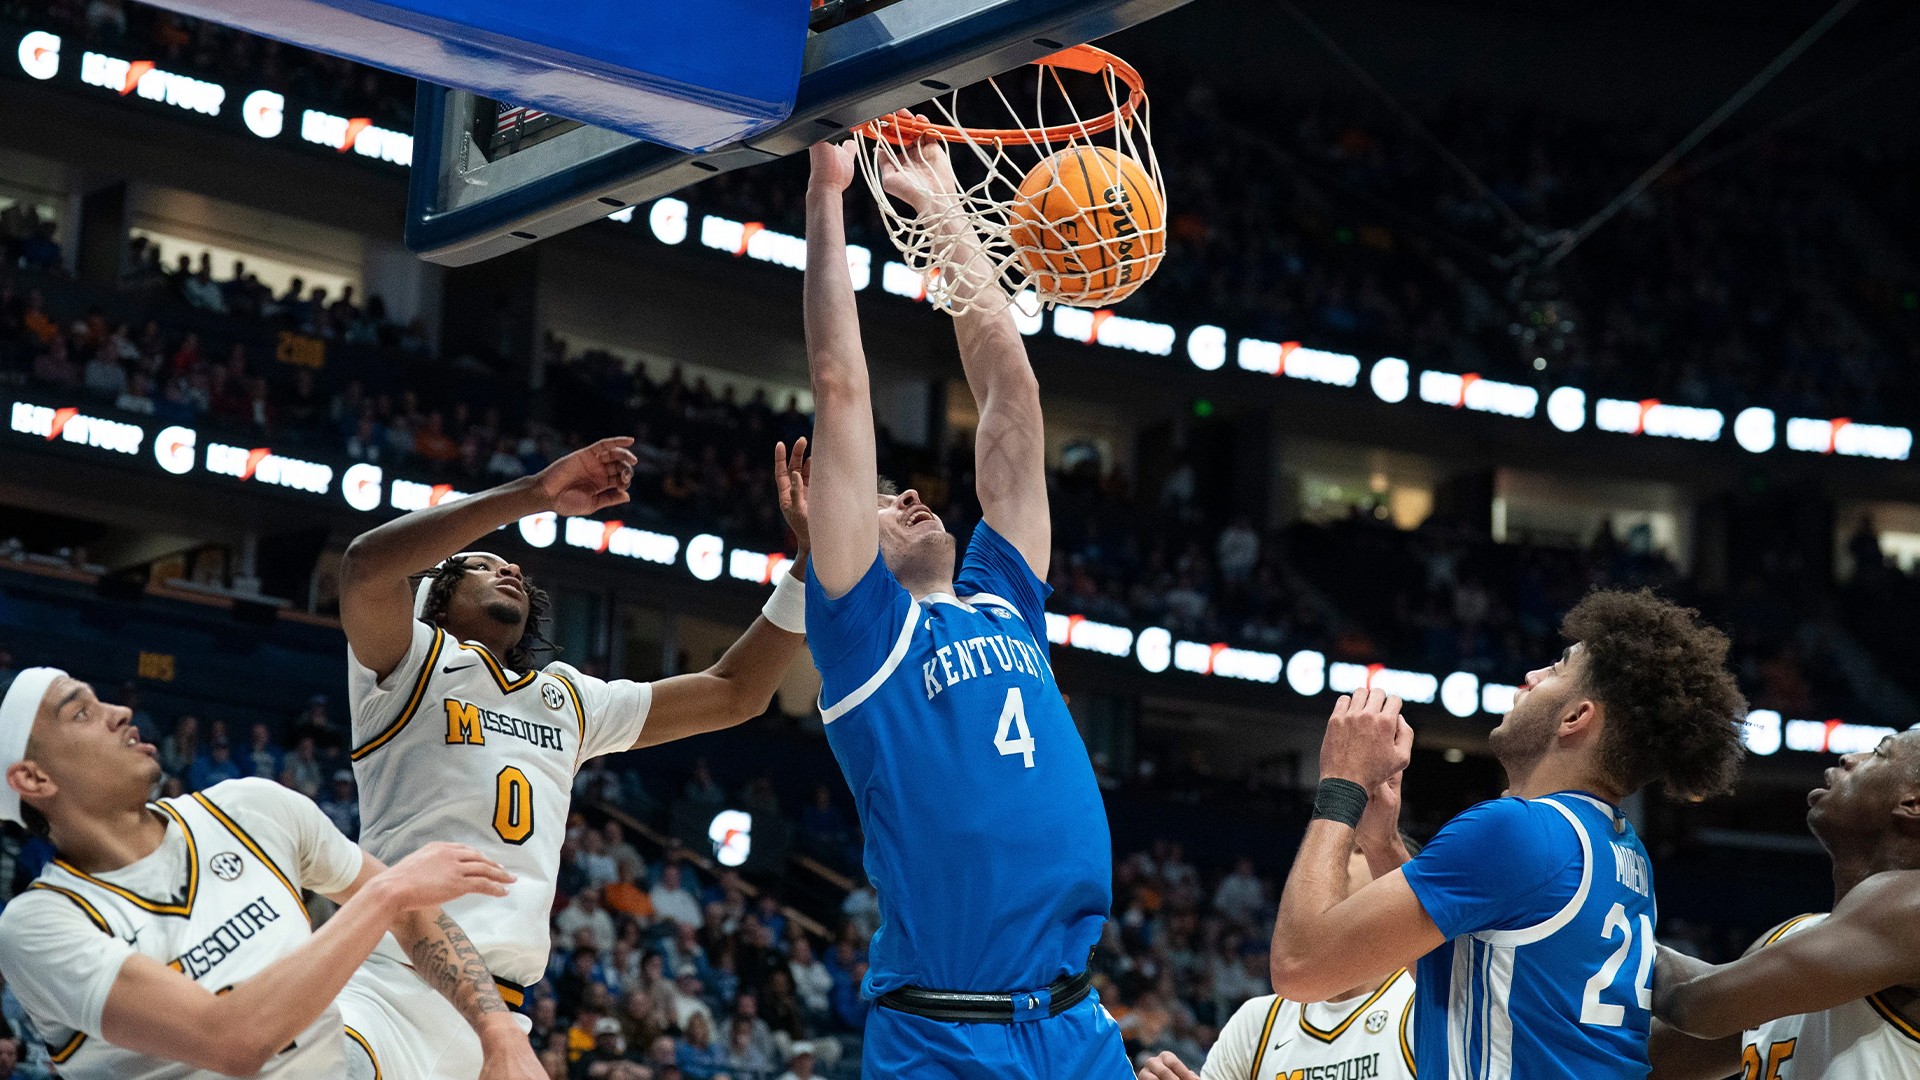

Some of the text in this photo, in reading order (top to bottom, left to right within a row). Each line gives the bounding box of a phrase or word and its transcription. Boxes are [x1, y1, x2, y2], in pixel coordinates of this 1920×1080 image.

[18, 31, 60, 79] G
[243, 89, 284, 137] G
[155, 425, 196, 474] G
[342, 463, 382, 510] G
[443, 698, 564, 752] MISSOURI
[993, 687, 1036, 768] 4
[491, 764, 535, 847] 0
[167, 896, 281, 981] ISSOURI
